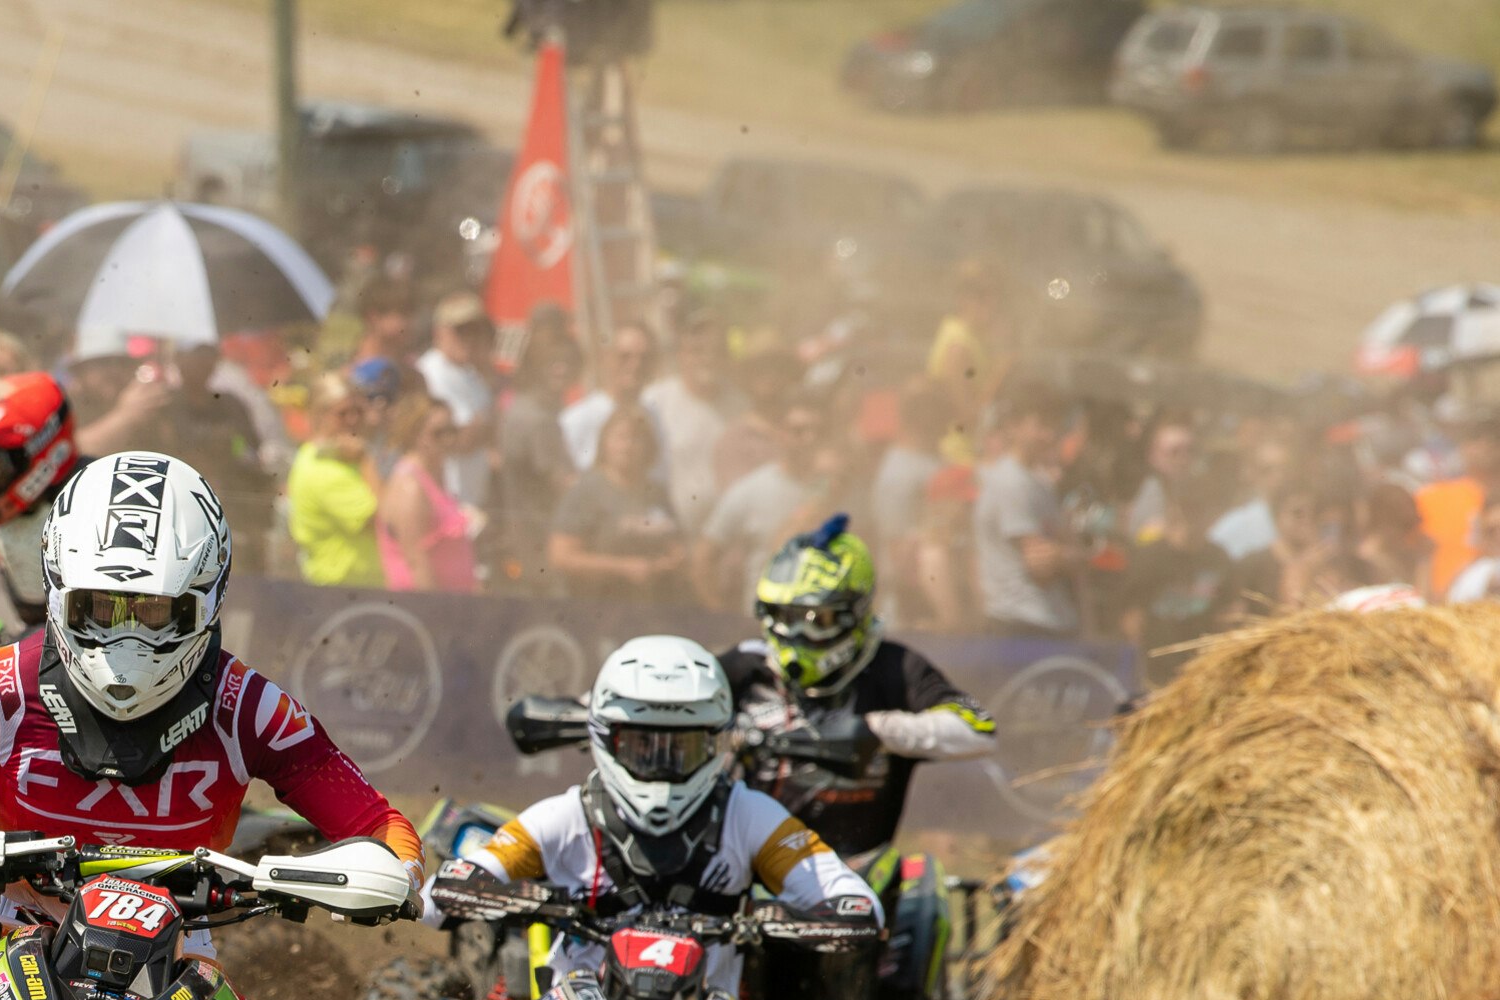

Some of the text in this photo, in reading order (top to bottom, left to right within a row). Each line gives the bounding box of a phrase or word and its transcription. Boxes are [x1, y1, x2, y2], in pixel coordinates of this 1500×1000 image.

[221, 672, 242, 711] FXR
[159, 701, 211, 754] LEATT
[16, 746, 220, 817] FXR
[88, 890, 170, 932] 784
[638, 939, 677, 968] 4
